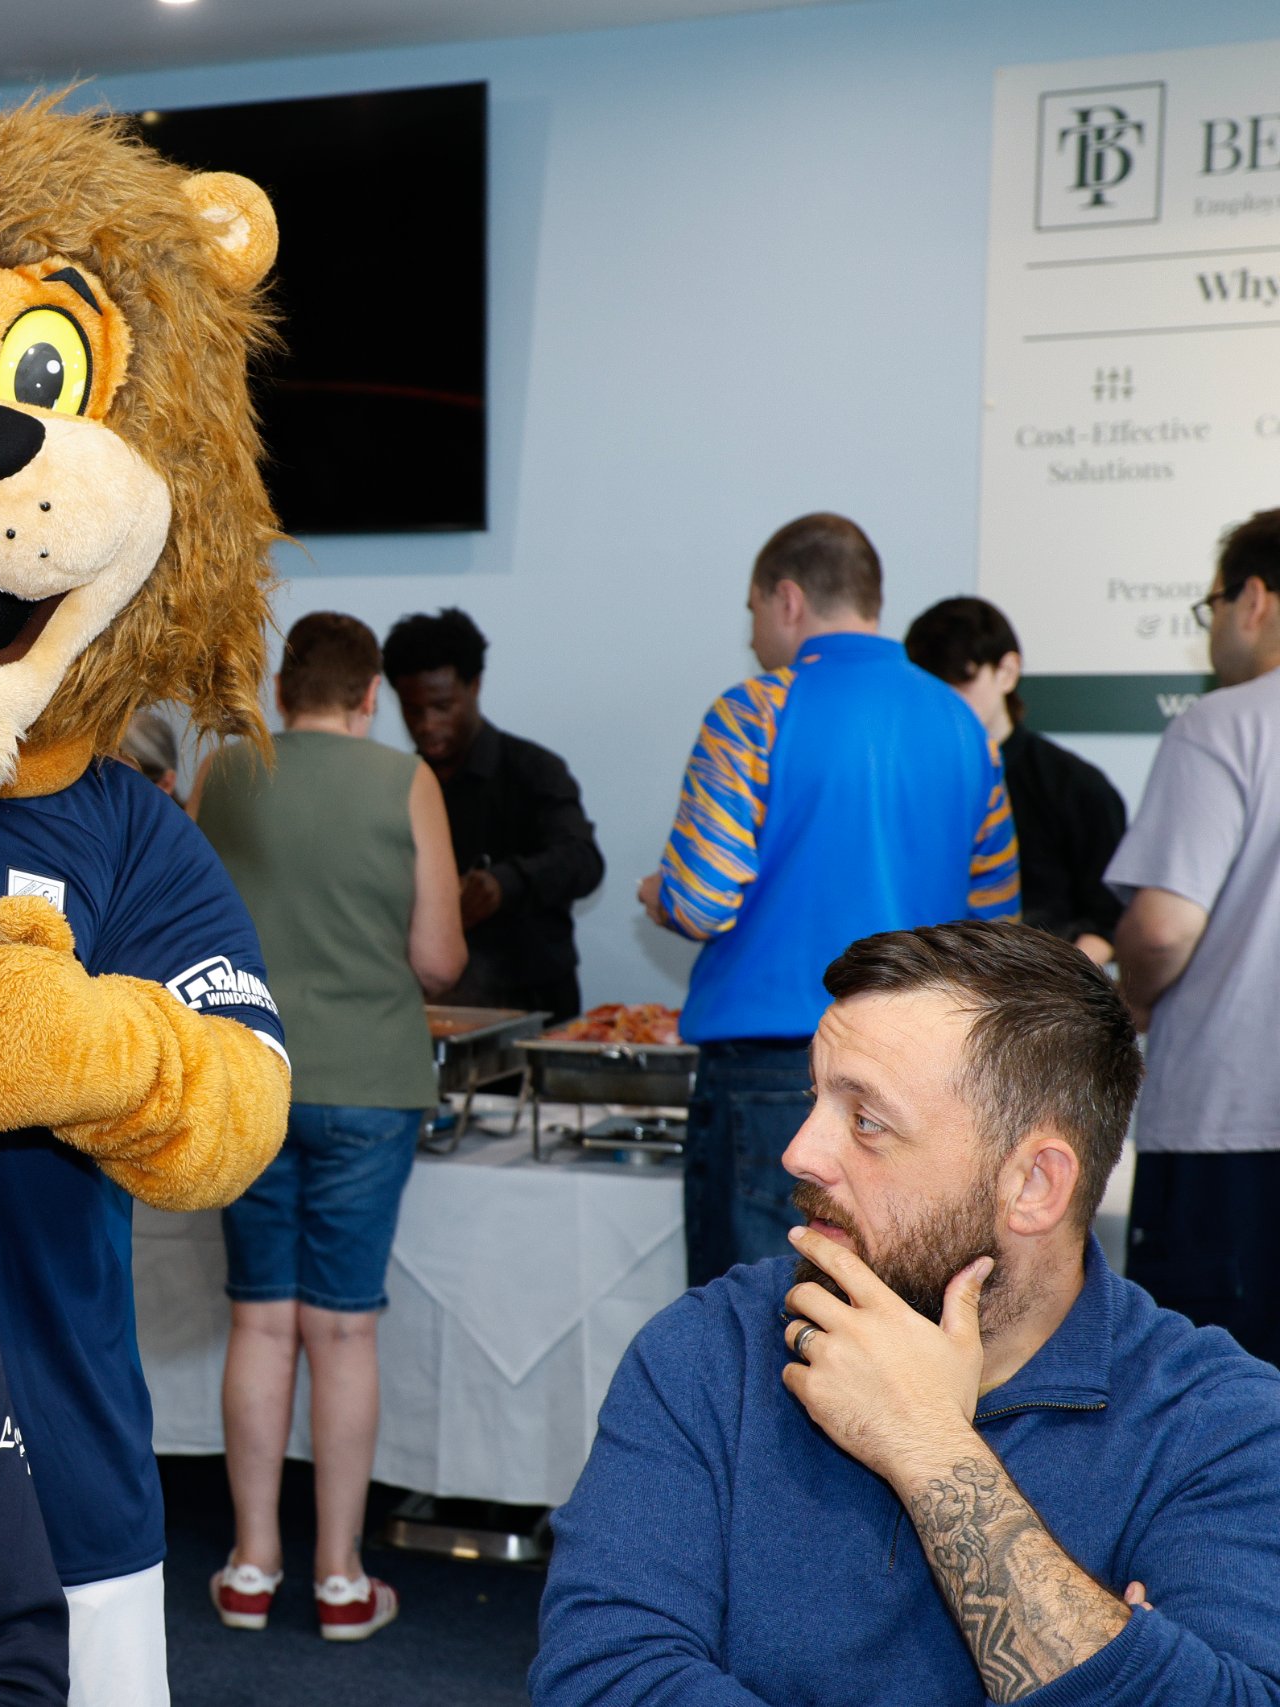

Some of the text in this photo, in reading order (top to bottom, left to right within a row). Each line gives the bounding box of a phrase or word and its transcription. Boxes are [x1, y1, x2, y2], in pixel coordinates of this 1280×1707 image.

[1015, 416, 1210, 448] Cost-Effective
[1047, 458, 1175, 484] Solutions
[206, 991, 266, 1007] WINDOWS
